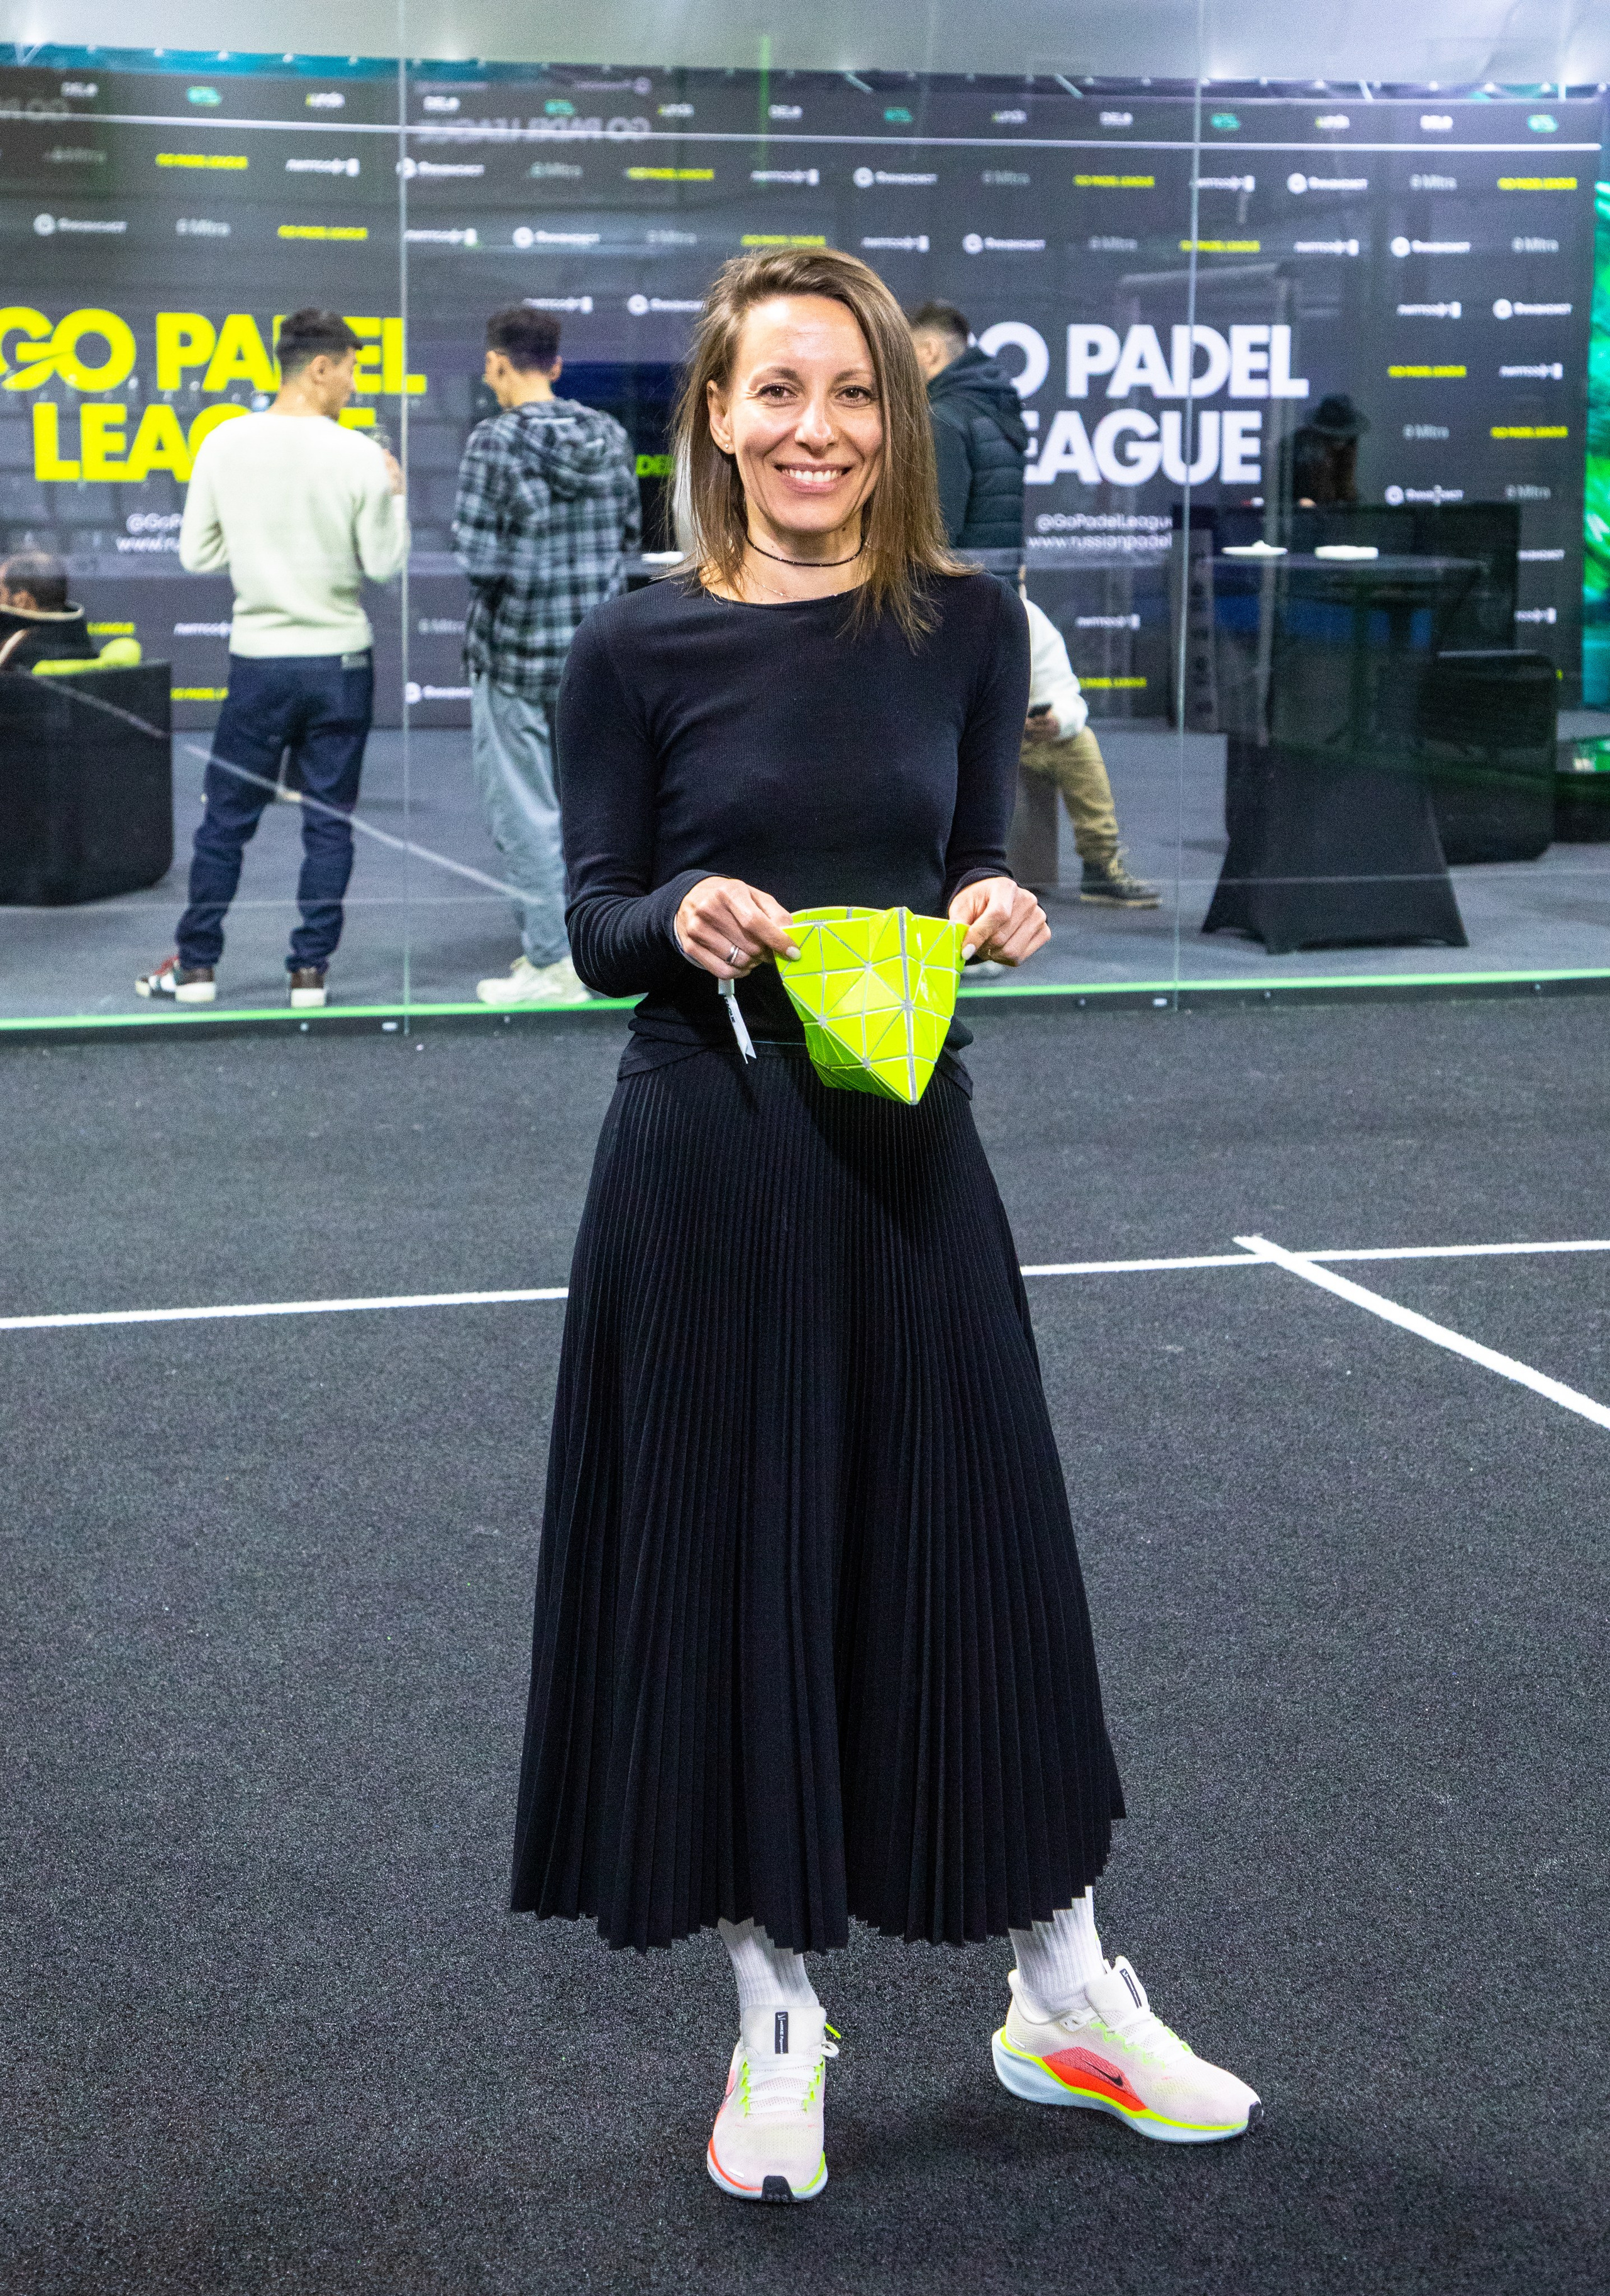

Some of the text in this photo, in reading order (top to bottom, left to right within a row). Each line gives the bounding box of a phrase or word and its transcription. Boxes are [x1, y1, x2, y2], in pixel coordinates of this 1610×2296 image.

[0, 306, 136, 392] GO
[969, 321, 1310, 399] O PADEL
